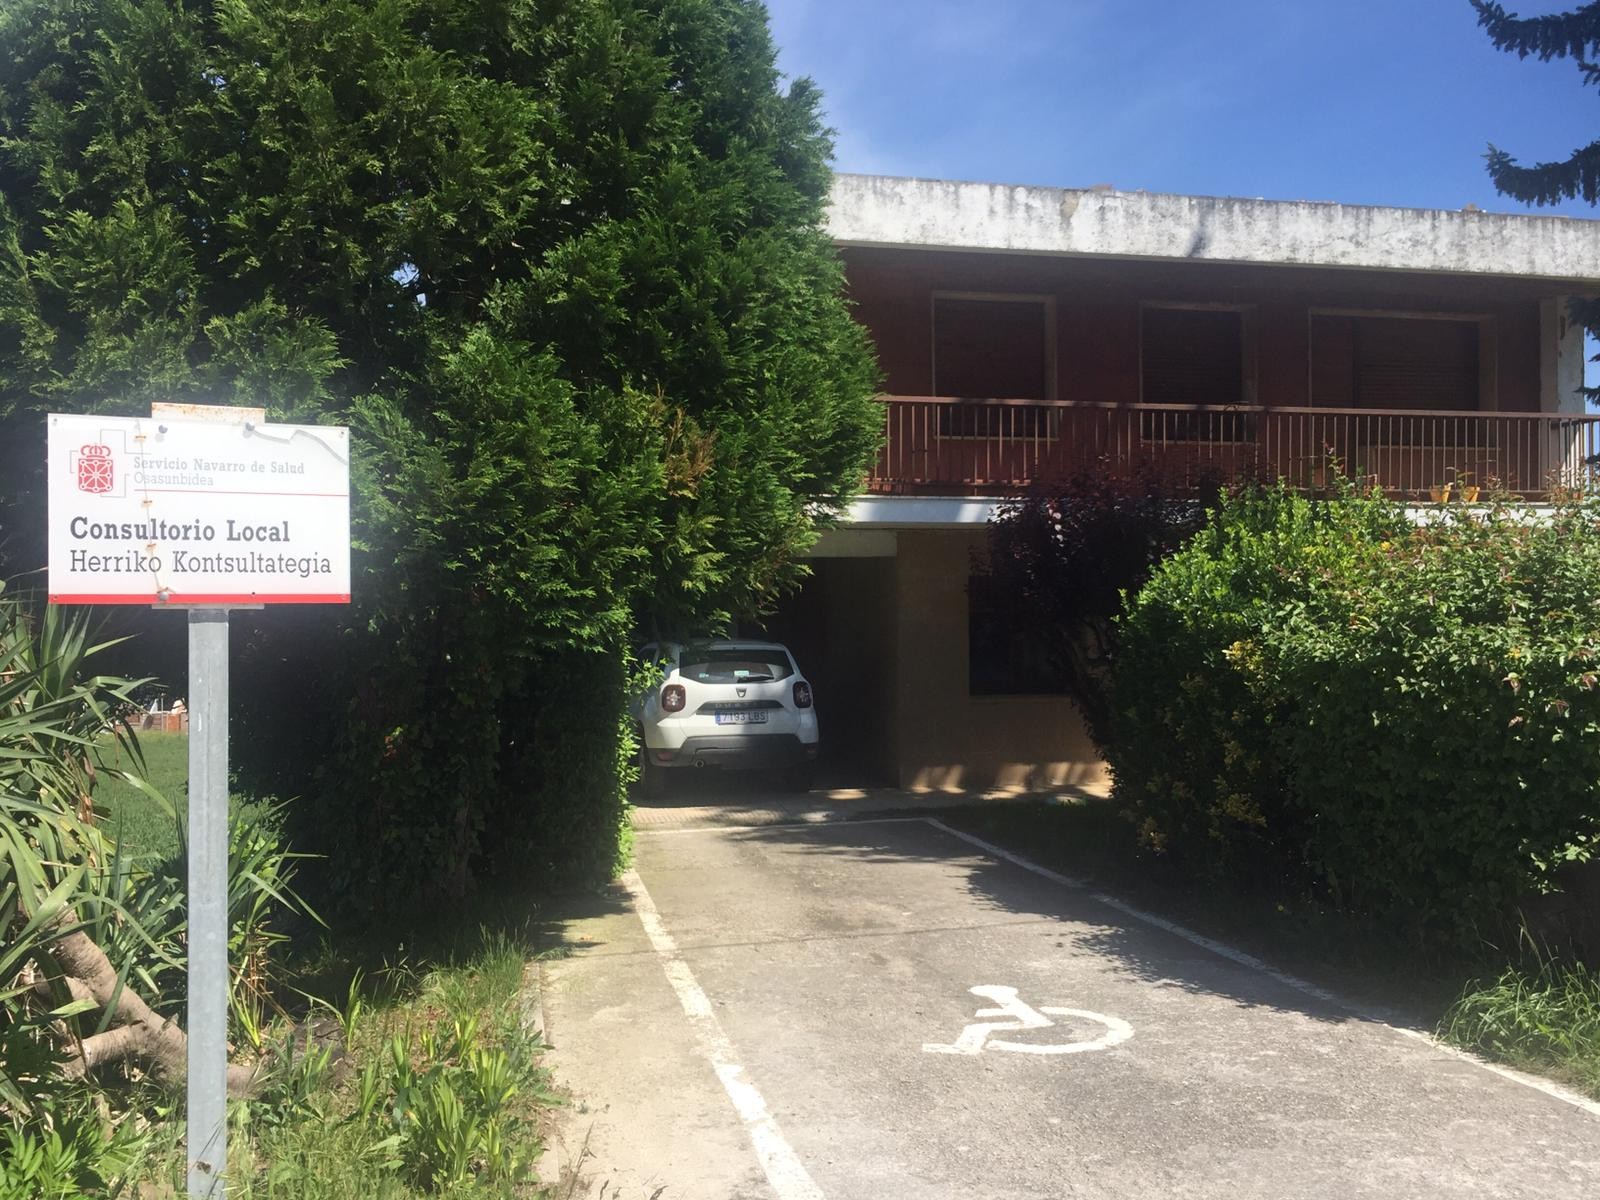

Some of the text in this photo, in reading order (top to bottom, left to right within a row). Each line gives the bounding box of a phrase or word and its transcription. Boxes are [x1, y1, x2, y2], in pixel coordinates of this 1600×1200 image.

[134, 457, 305, 474] Servicio Navarro de Salud
[134, 472, 214, 486] Osasunbidea
[70, 517, 290, 542] Consultorio Local
[70, 550, 332, 578] Herriko Kontsultategia
[722, 711, 746, 721] 7193
